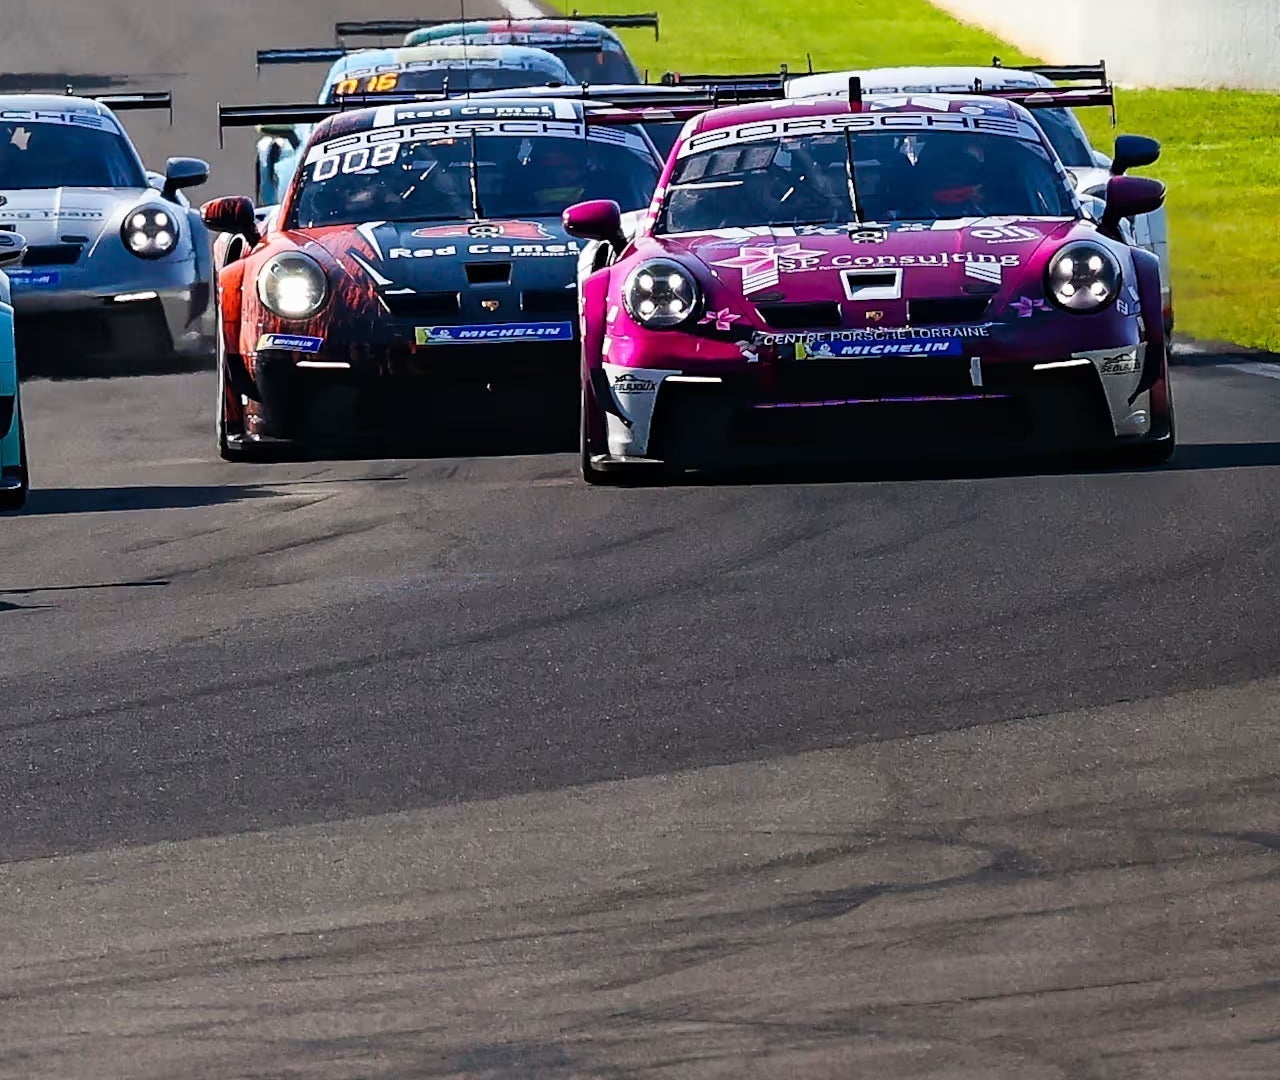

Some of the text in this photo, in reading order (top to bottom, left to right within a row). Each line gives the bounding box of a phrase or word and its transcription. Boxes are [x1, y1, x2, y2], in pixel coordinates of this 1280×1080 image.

[397, 105, 550, 120] Red Camel
[324, 123, 627, 155] PORSCHE
[690, 115, 1019, 151] PORSCHE
[312, 142, 401, 183] 008
[42, 209, 103, 219] Team
[389, 241, 580, 259] Red Camel
[778, 257, 818, 270] SP
[831, 251, 1020, 267] Consulting
[458, 326, 562, 340] MICHELIN
[763, 326, 991, 347] CENTRE PORSCHE LORRAINE
[840, 341, 951, 355] MICHELIN
